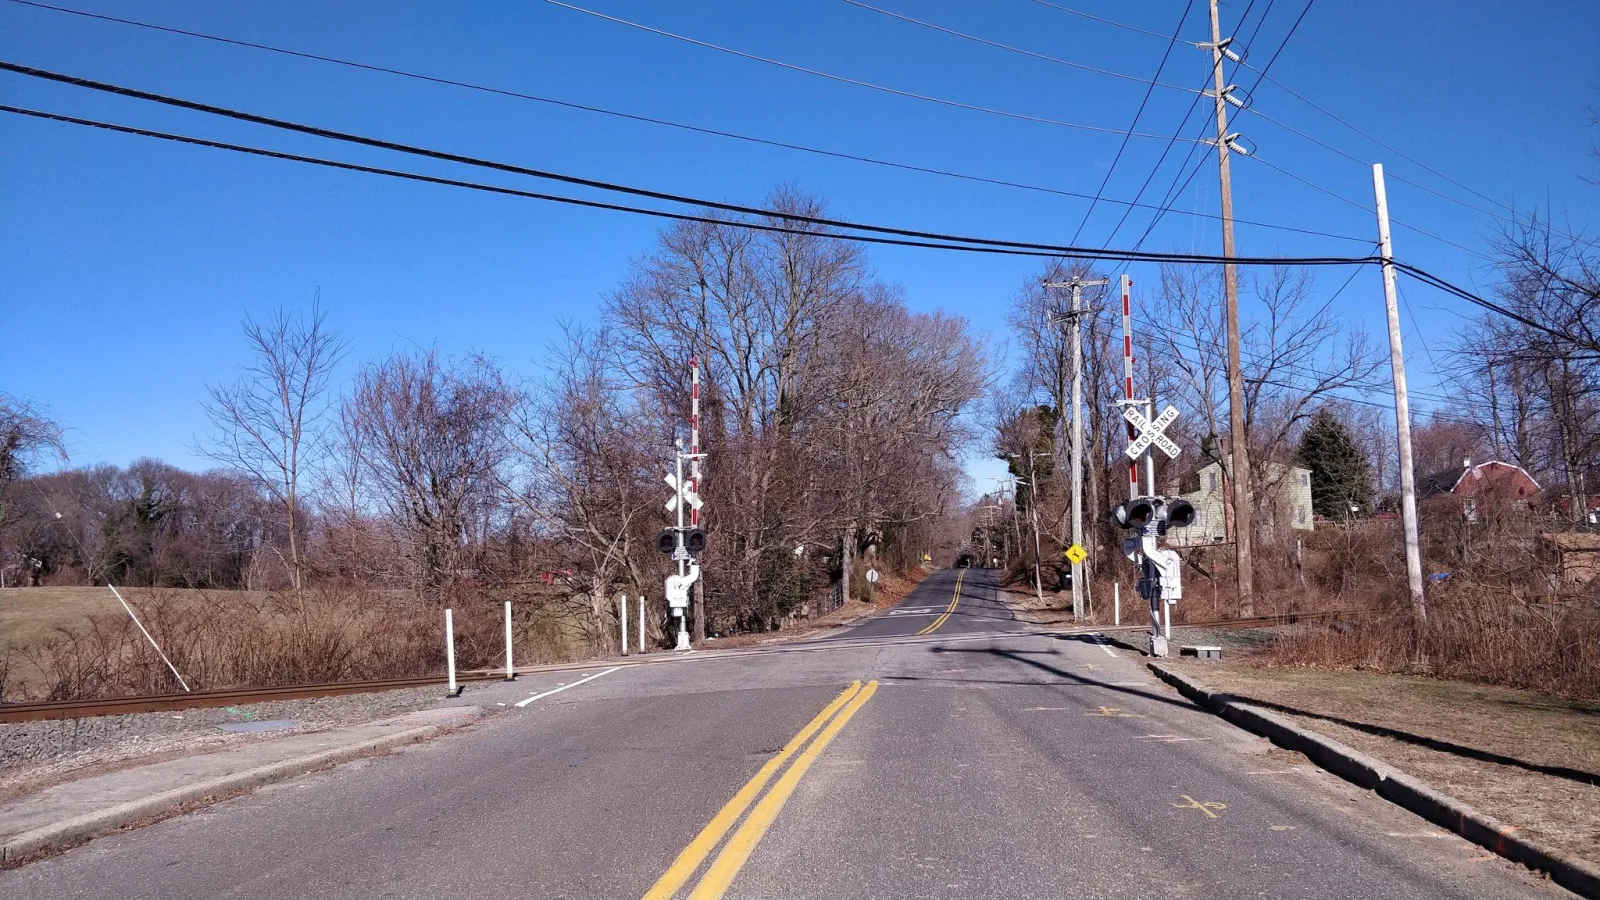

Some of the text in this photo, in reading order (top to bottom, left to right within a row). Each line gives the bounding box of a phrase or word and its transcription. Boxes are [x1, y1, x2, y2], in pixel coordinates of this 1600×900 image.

[1126, 410, 1178, 456] RAIL ROAD
[1130, 410, 1175, 455] CROSSING
